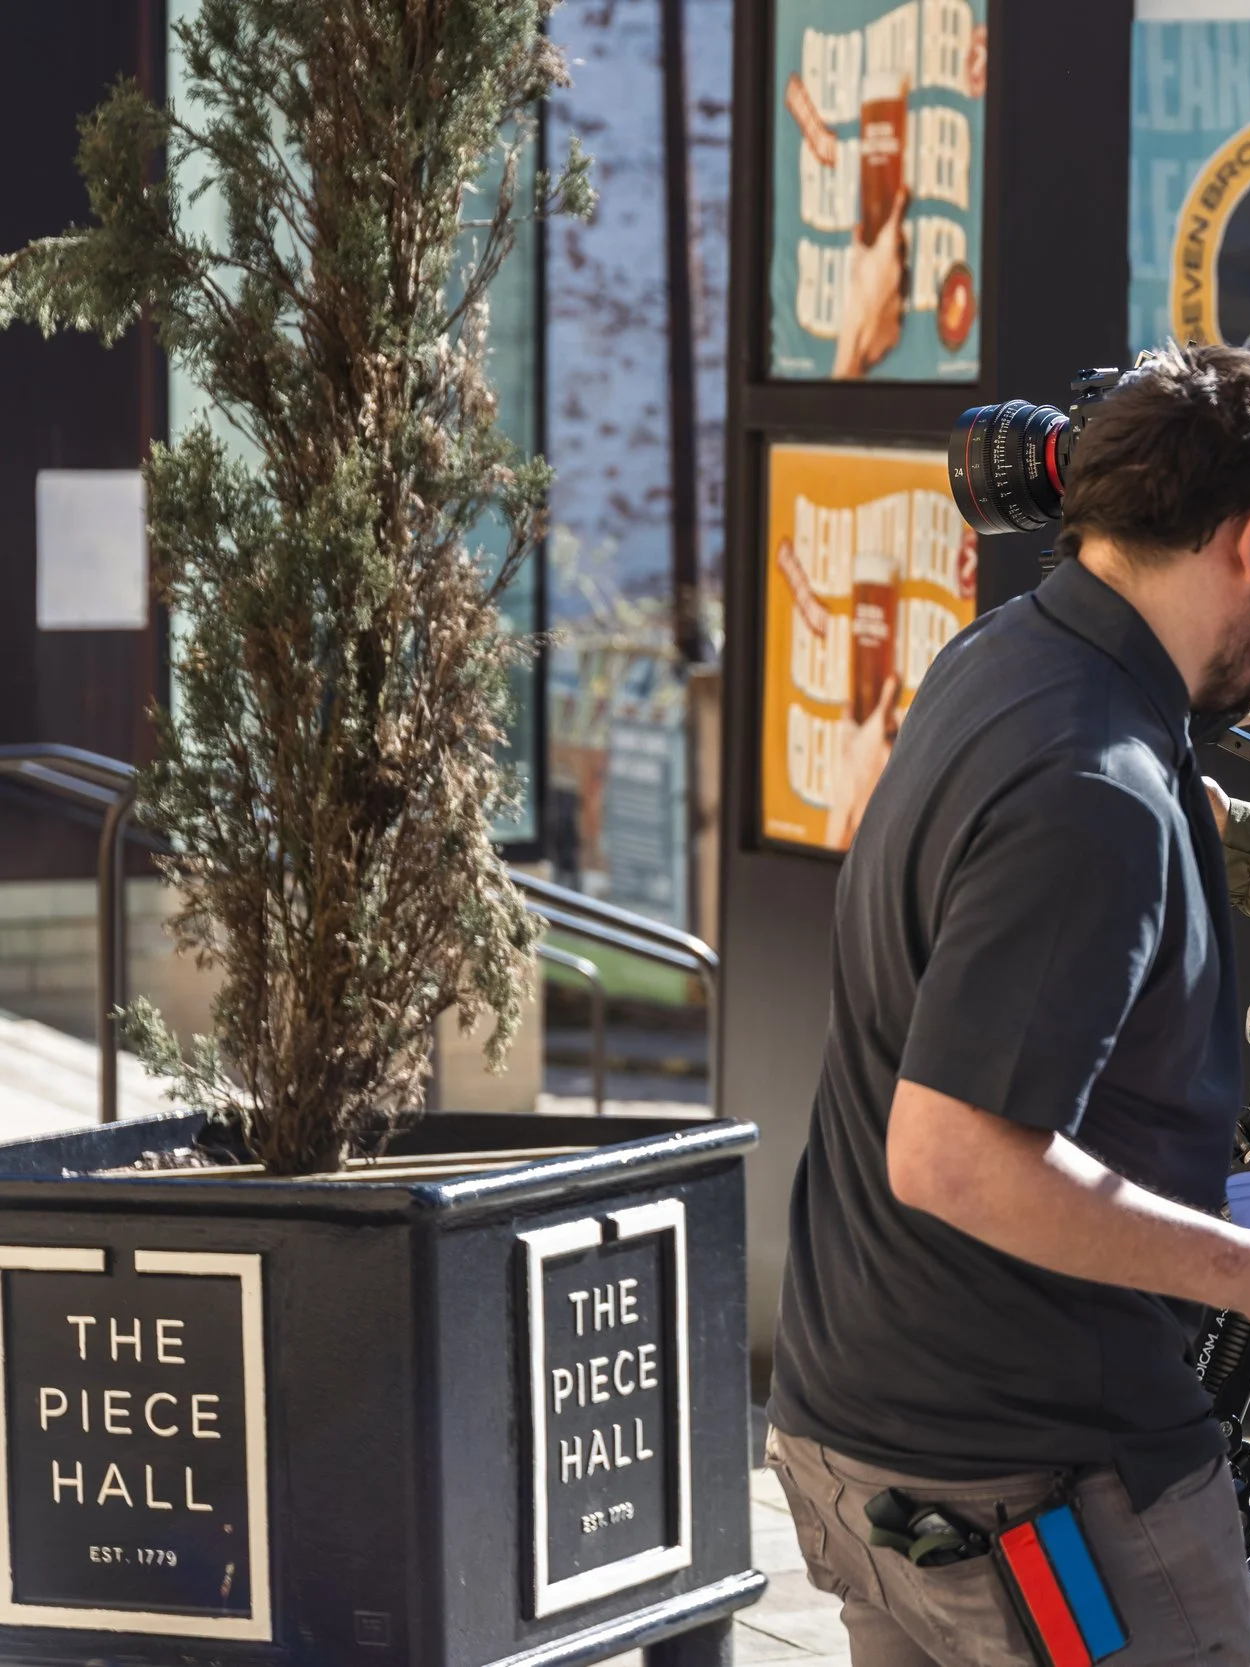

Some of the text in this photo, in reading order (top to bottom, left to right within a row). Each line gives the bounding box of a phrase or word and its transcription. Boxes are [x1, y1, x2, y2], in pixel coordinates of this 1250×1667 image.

[954, 467, 964, 478] 24
[569, 1278, 640, 1337] THE
[67, 1315, 186, 1364] THE
[552, 1343, 659, 1415] PIECE
[39, 1387, 221, 1439] PIECE
[560, 1417, 654, 1484] HALL
[52, 1460, 213, 1512] HALL
[89, 1546, 178, 1567] EST. 1779
